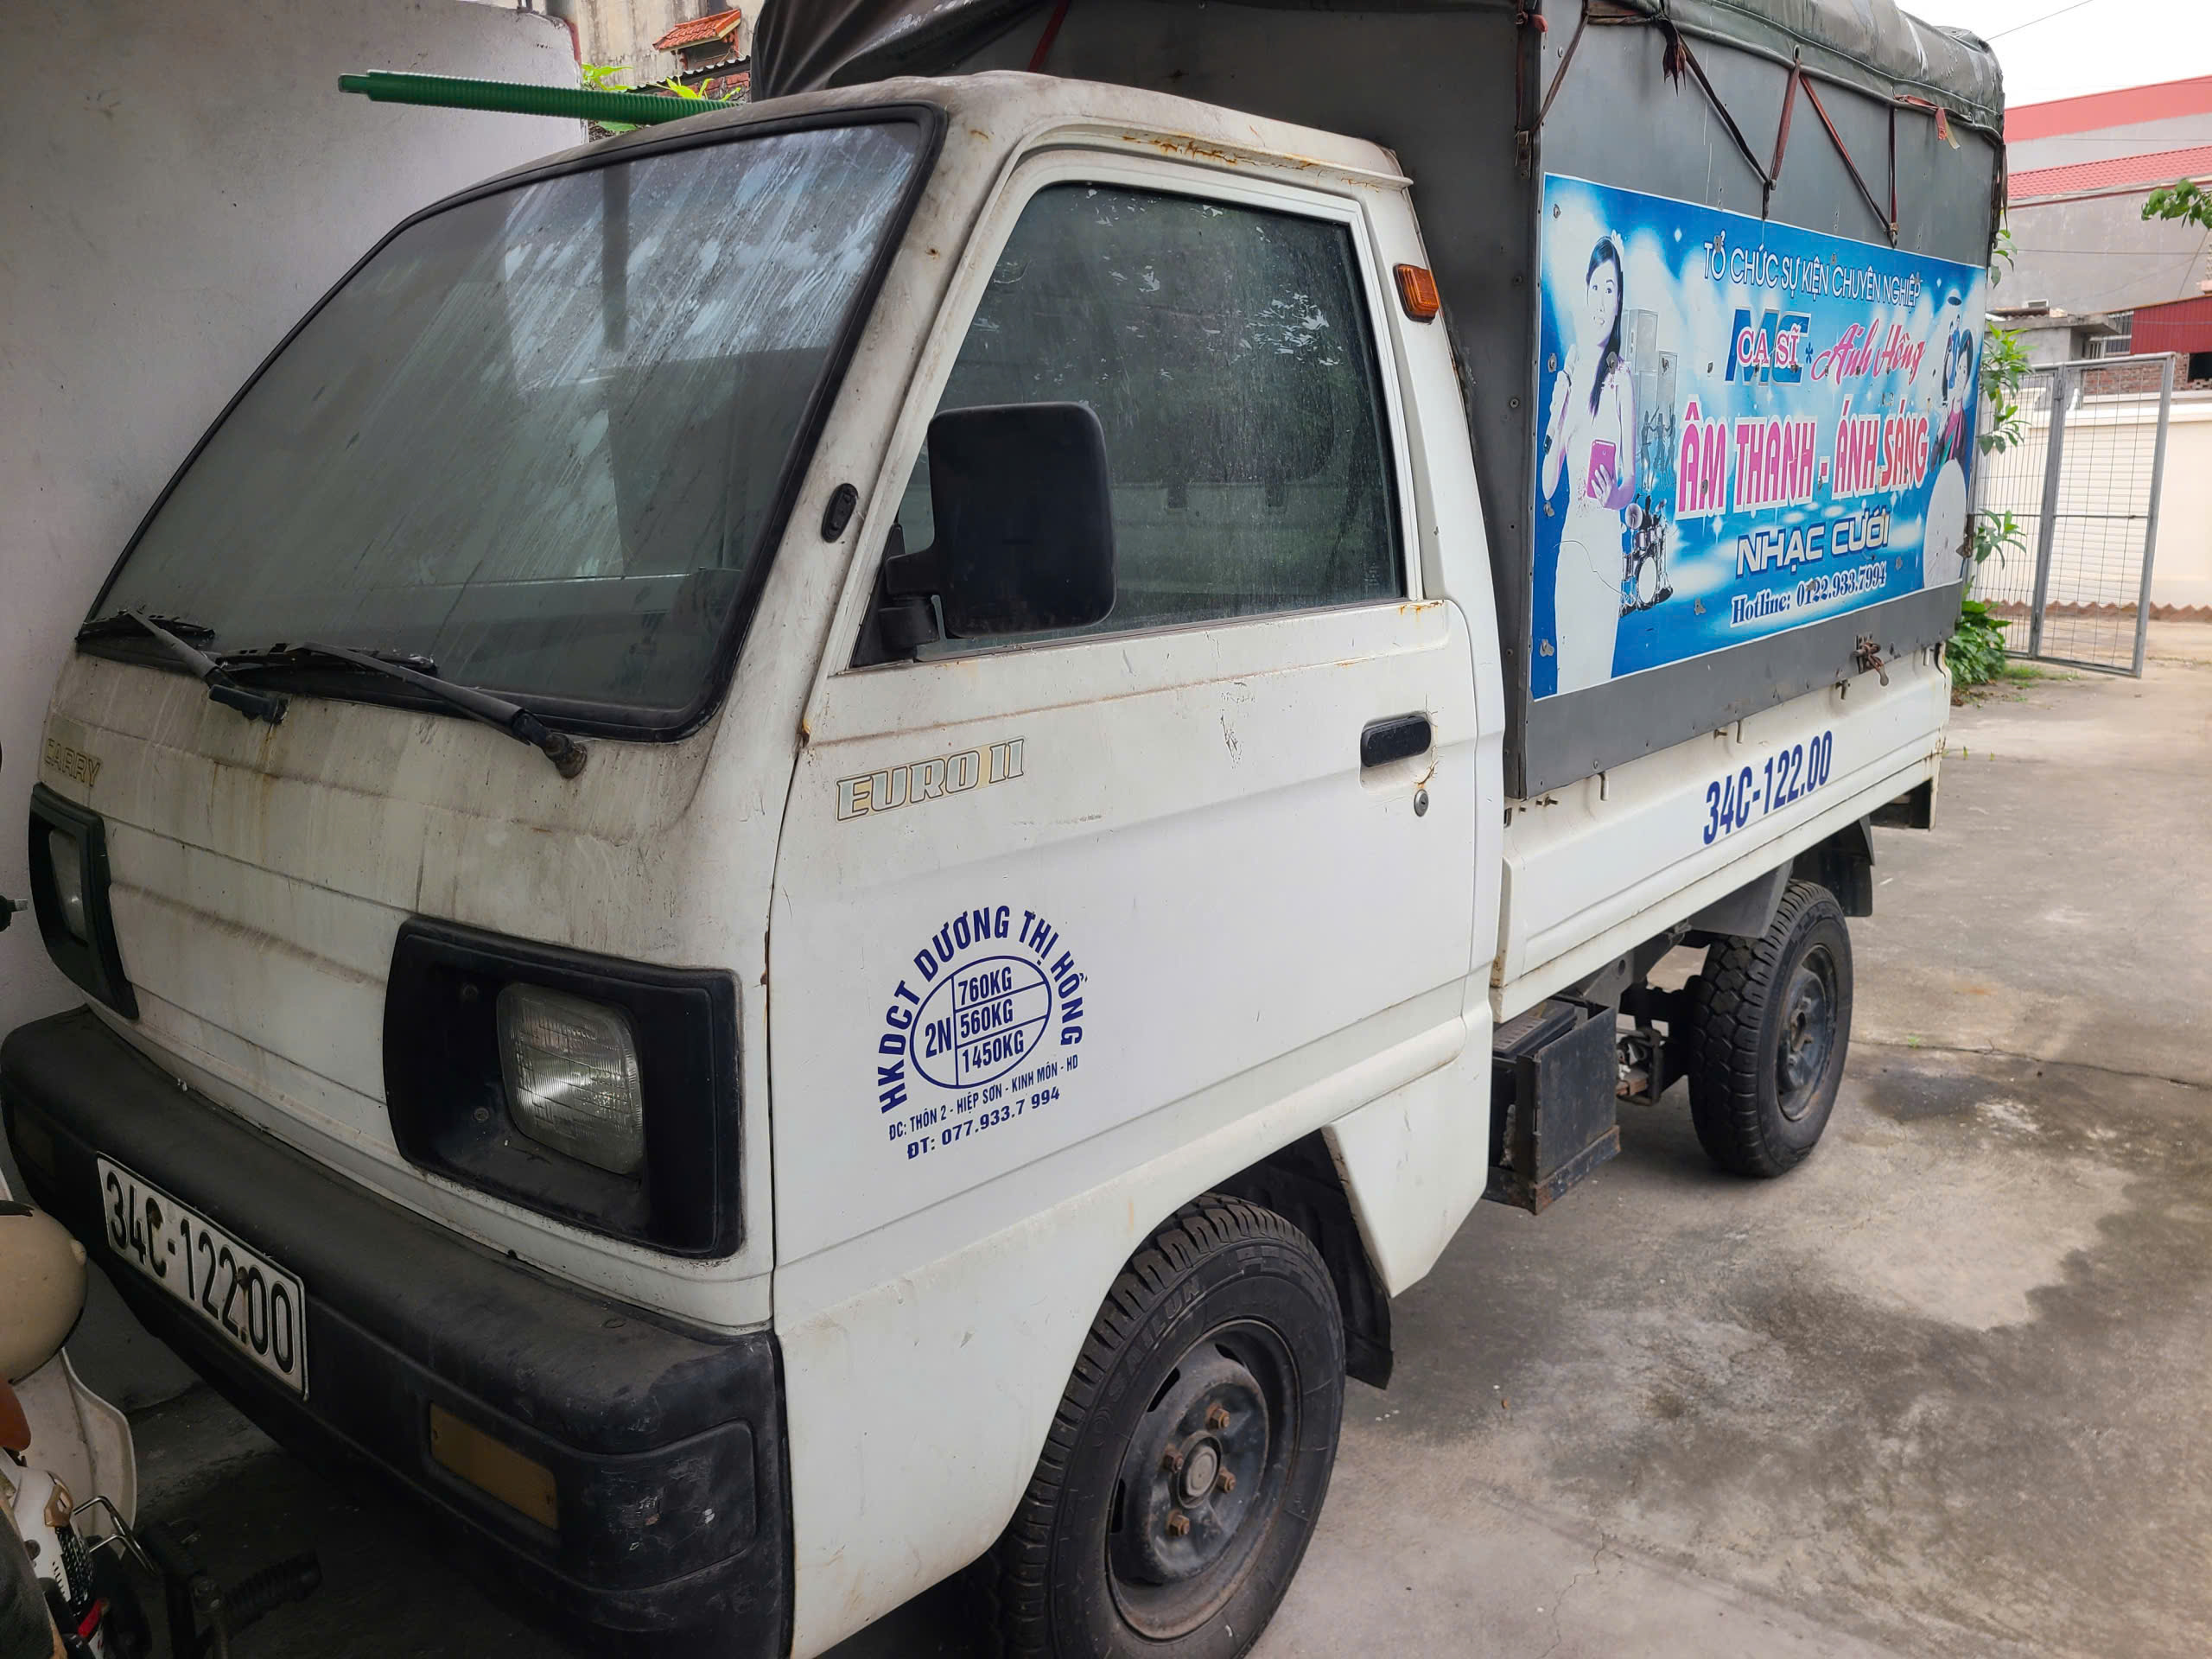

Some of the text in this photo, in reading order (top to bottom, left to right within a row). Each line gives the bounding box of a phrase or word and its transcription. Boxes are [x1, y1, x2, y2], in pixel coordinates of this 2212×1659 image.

[1730, 244, 1778, 288] CHỨC
[1781, 257, 1801, 298] SỰ
[1802, 256, 1829, 301] KIỆN
[1832, 266, 1880, 302] CHUYÊN
[1882, 272, 1921, 313] NGHIỆP
[1872, 324, 1925, 385] Hồng
[1679, 401, 1726, 513] ÂM
[1736, 421, 1815, 506] THANH
[1834, 399, 1878, 493] ÁNH
[1881, 399, 1928, 486] SÁNG
[1737, 505, 1890, 576] NHẠC CƯỚI
[1732, 594, 1791, 625] Hotline:
[836, 739, 1024, 821] EURO II
[1703, 730, 1833, 844] 34C-122.00
[878, 906, 1088, 1114] HKDCT DƯƠNG THỊ HỒNG
[958, 966, 1012, 1005] 760KG
[960, 999, 1013, 1039] 560KG
[925, 1017, 952, 1058] 2N
[962, 1029, 1024, 1073] 1450KG
[889, 1122, 907, 1141] ĐC:
[910, 1108, 938, 1132] THÔN
[941, 1104, 947, 1121] 2
[957, 1091, 980, 1115] HIỆP
[982, 1084, 1002, 1105] SƠN
[1012, 1071, 1034, 1093] KINH
[1066, 1054, 1078, 1072] HD
[907, 1136, 936, 1160] ĐT:
[106, 1170, 295, 1375] 34C-122.00
